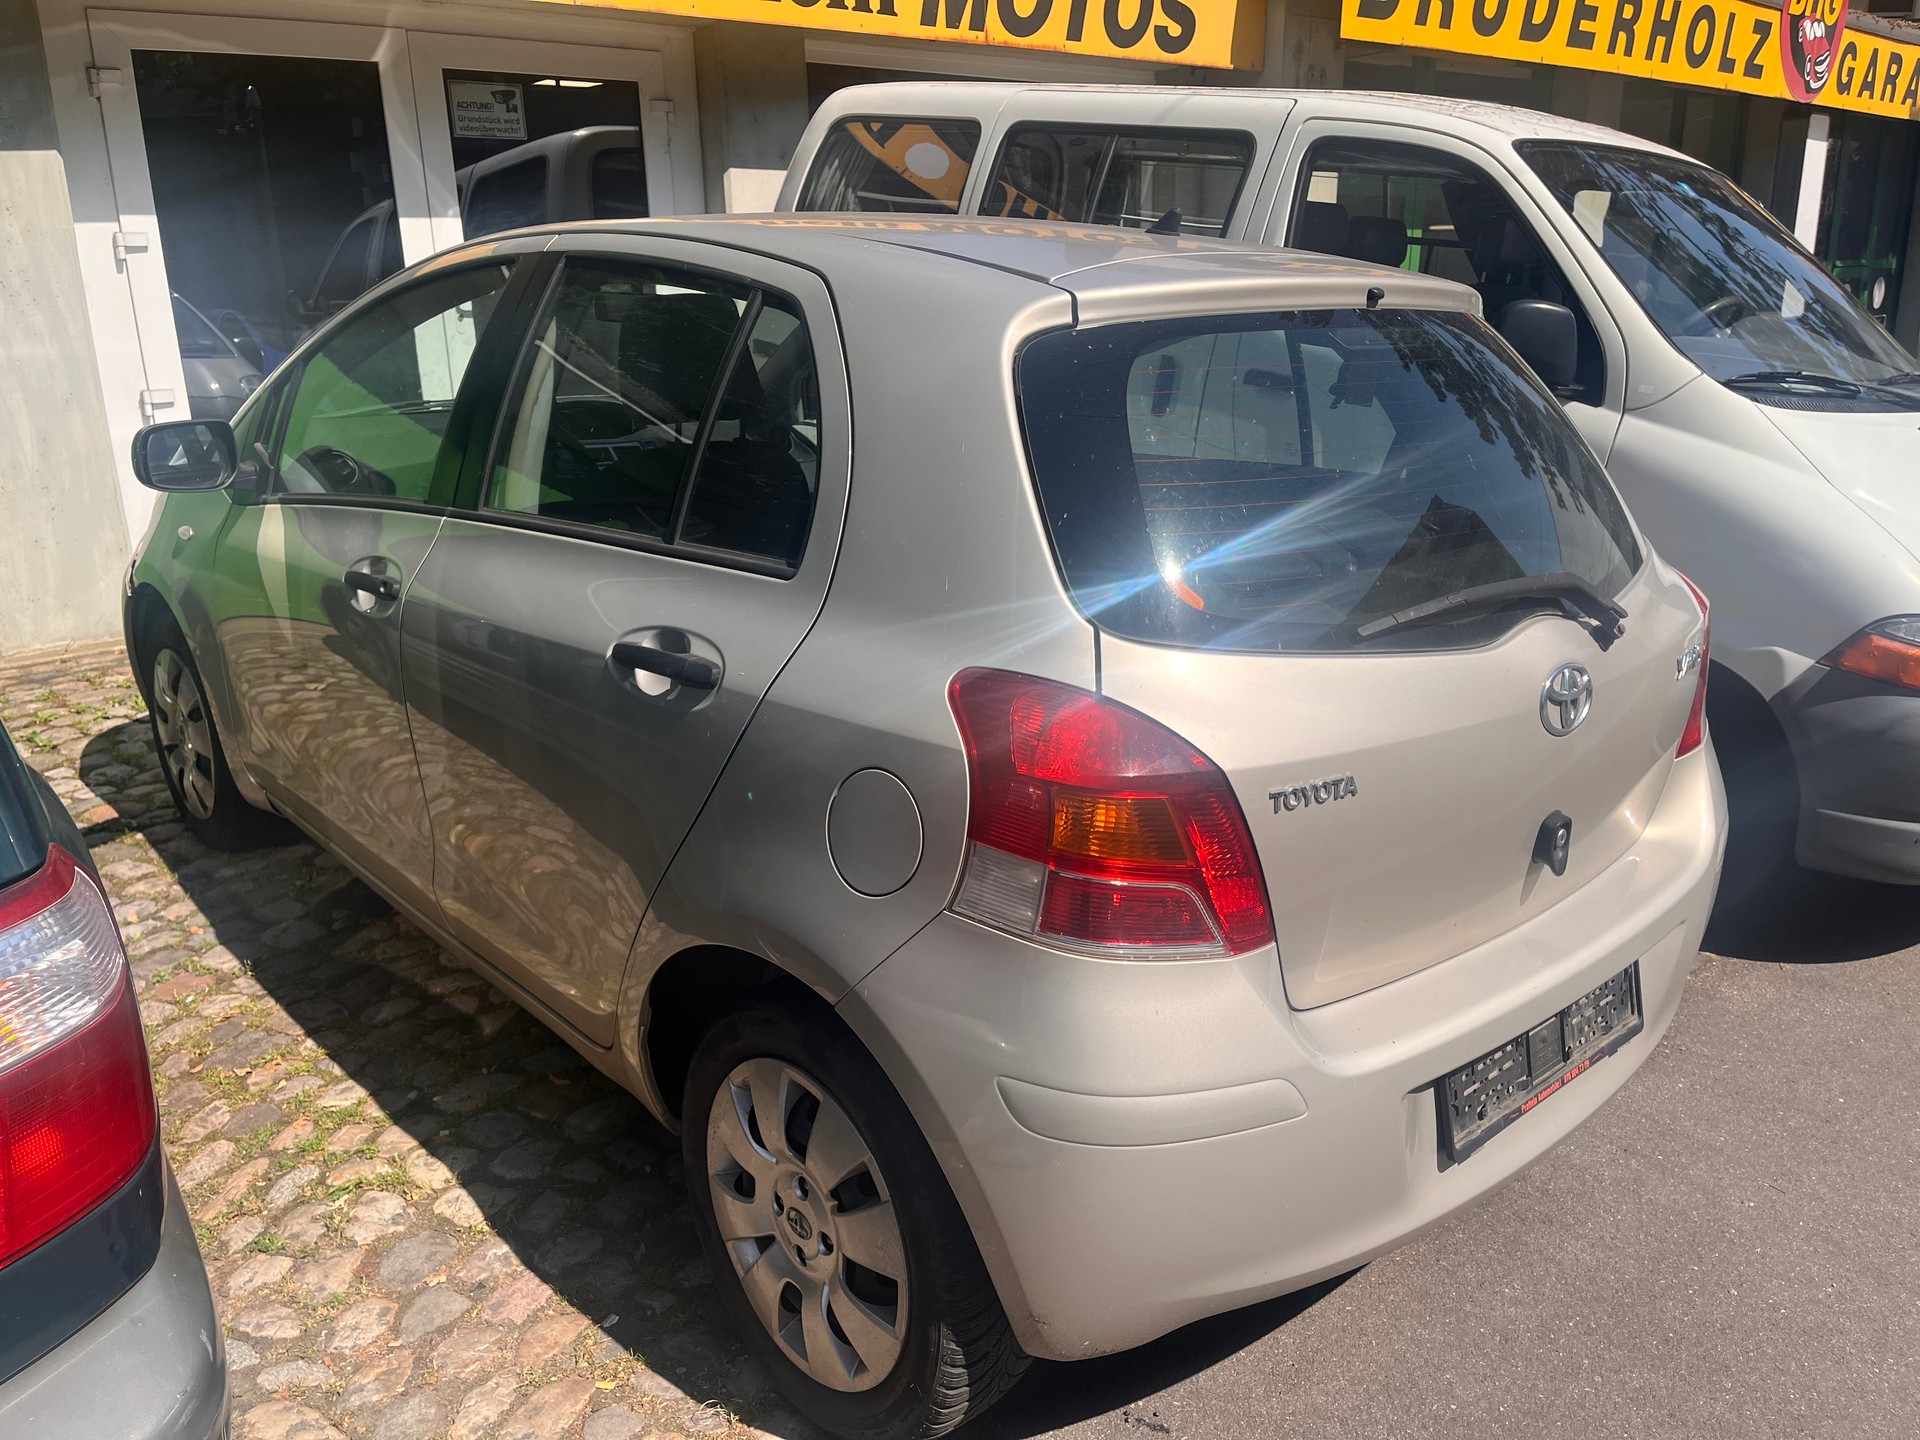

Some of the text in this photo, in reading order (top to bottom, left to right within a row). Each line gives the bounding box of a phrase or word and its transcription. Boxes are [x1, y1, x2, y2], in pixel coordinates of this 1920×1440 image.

[1357, 0, 1773, 80] UDERHOLZ
[456, 101, 495, 111] ACHTUNG!
[457, 114, 520, 125] Grundstück wird
[458, 123, 521, 135] videoüberwacht!
[1268, 774, 1359, 815] TOYOTA
